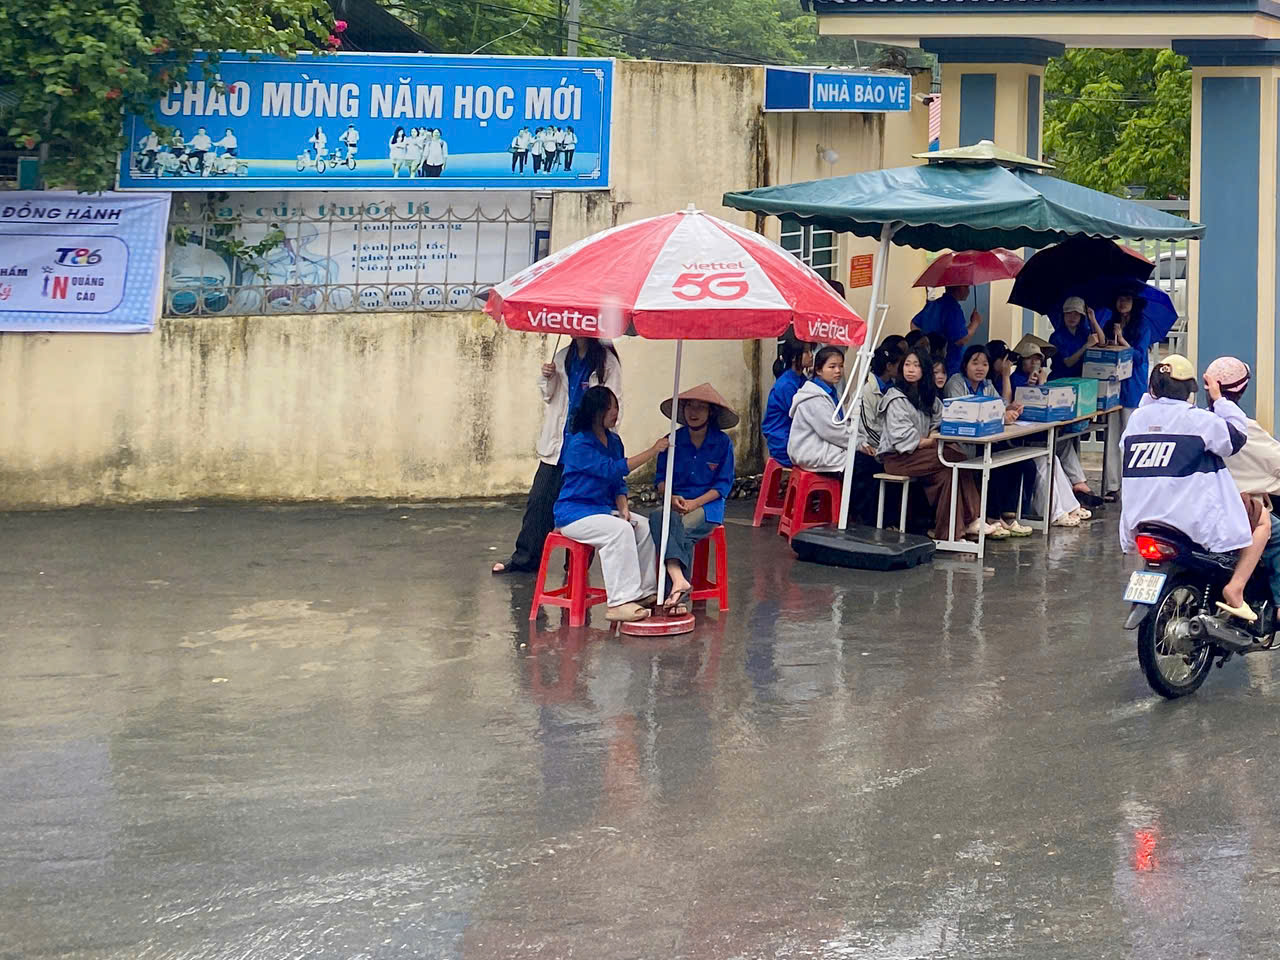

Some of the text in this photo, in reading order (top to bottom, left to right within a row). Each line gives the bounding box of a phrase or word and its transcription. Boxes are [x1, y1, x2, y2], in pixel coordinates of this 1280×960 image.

[160, 73, 582, 127] CHÀO MỪNG NĂM HỌC MỚI
[817, 78, 906, 108] NHÀ BẢO VỆ
[2, 202, 122, 220] ĐỒNG HÀNH
[393, 241, 420, 251] phổ
[682, 261, 745, 270] viettel
[72, 275, 104, 287] QUẢNG
[672, 272, 749, 300] 5G
[528, 308, 606, 332] viettel
[808, 318, 851, 342] viettel
